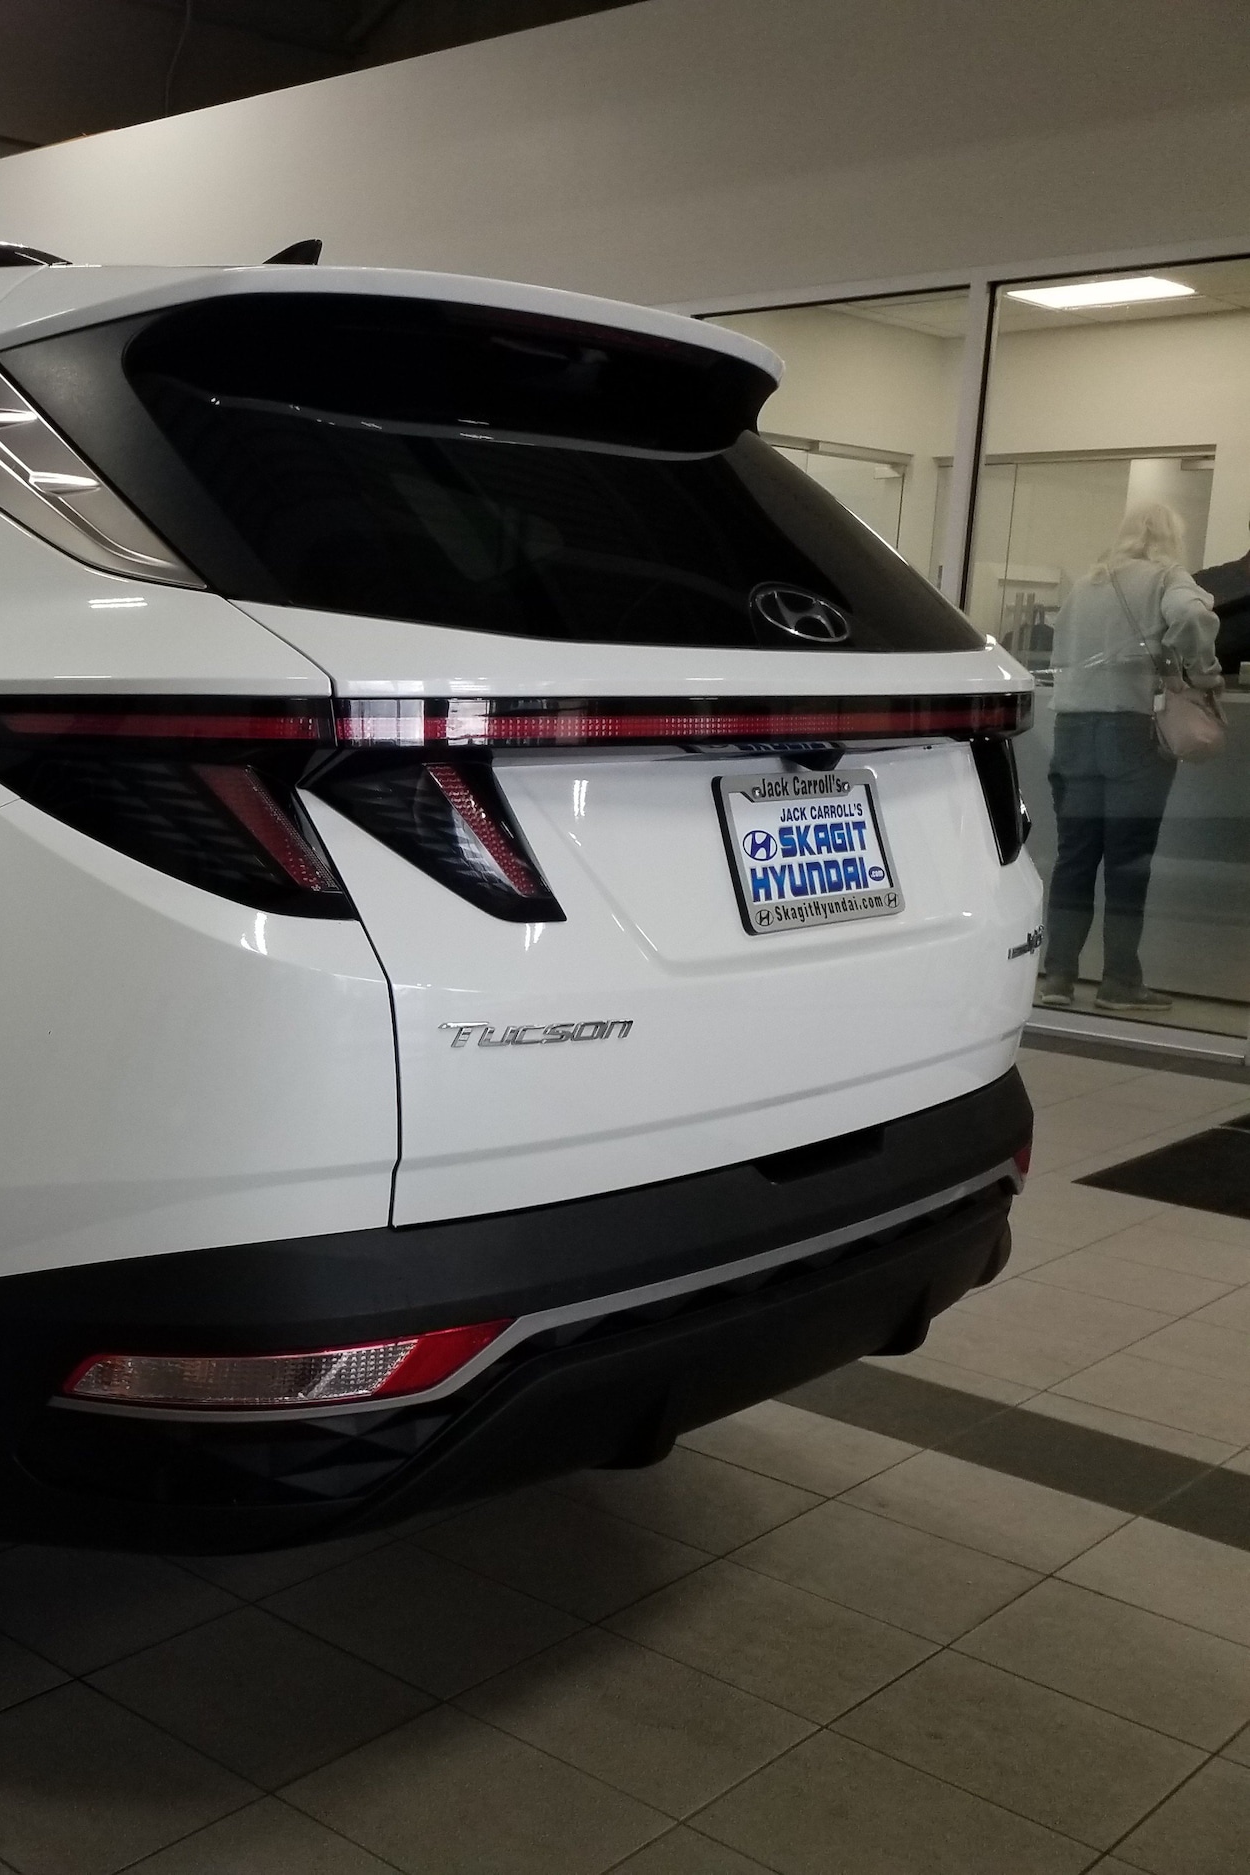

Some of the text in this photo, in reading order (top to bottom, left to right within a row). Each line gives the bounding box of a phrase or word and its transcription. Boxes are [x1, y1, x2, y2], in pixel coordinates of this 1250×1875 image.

[760, 774, 842, 798] Jack Carroll's
[780, 803, 863, 823] JACK CARROLL'S
[778, 820, 867, 859] SKAGIT
[750, 856, 870, 903] HYUNDAI
[774, 894, 884, 923] SkagitHyundai.com
